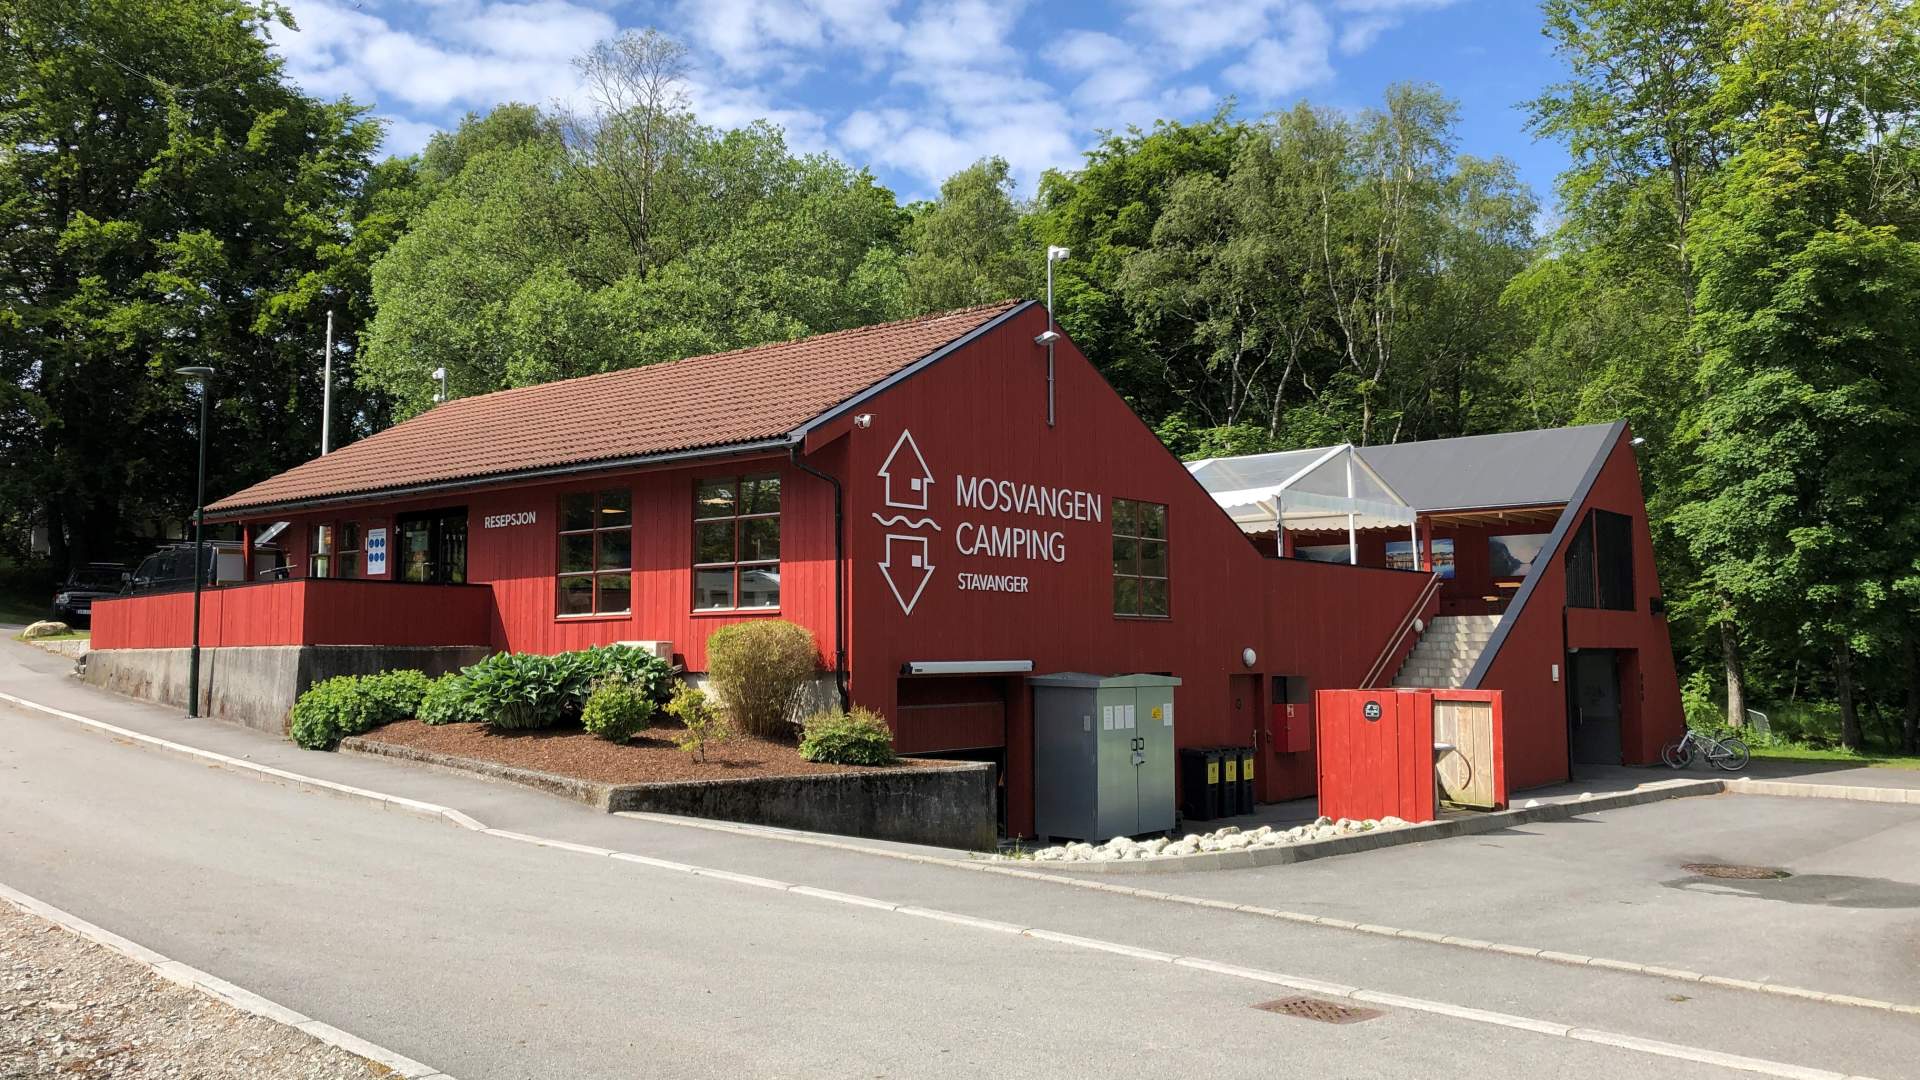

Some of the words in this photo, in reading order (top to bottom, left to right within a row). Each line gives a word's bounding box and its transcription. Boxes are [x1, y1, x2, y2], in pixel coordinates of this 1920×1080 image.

[956, 474, 1102, 522] MOSVANGEN
[484, 511, 536, 529] RESEPSJON
[955, 522, 1065, 563] CAMPING
[957, 572, 1029, 593] STAVANGER
